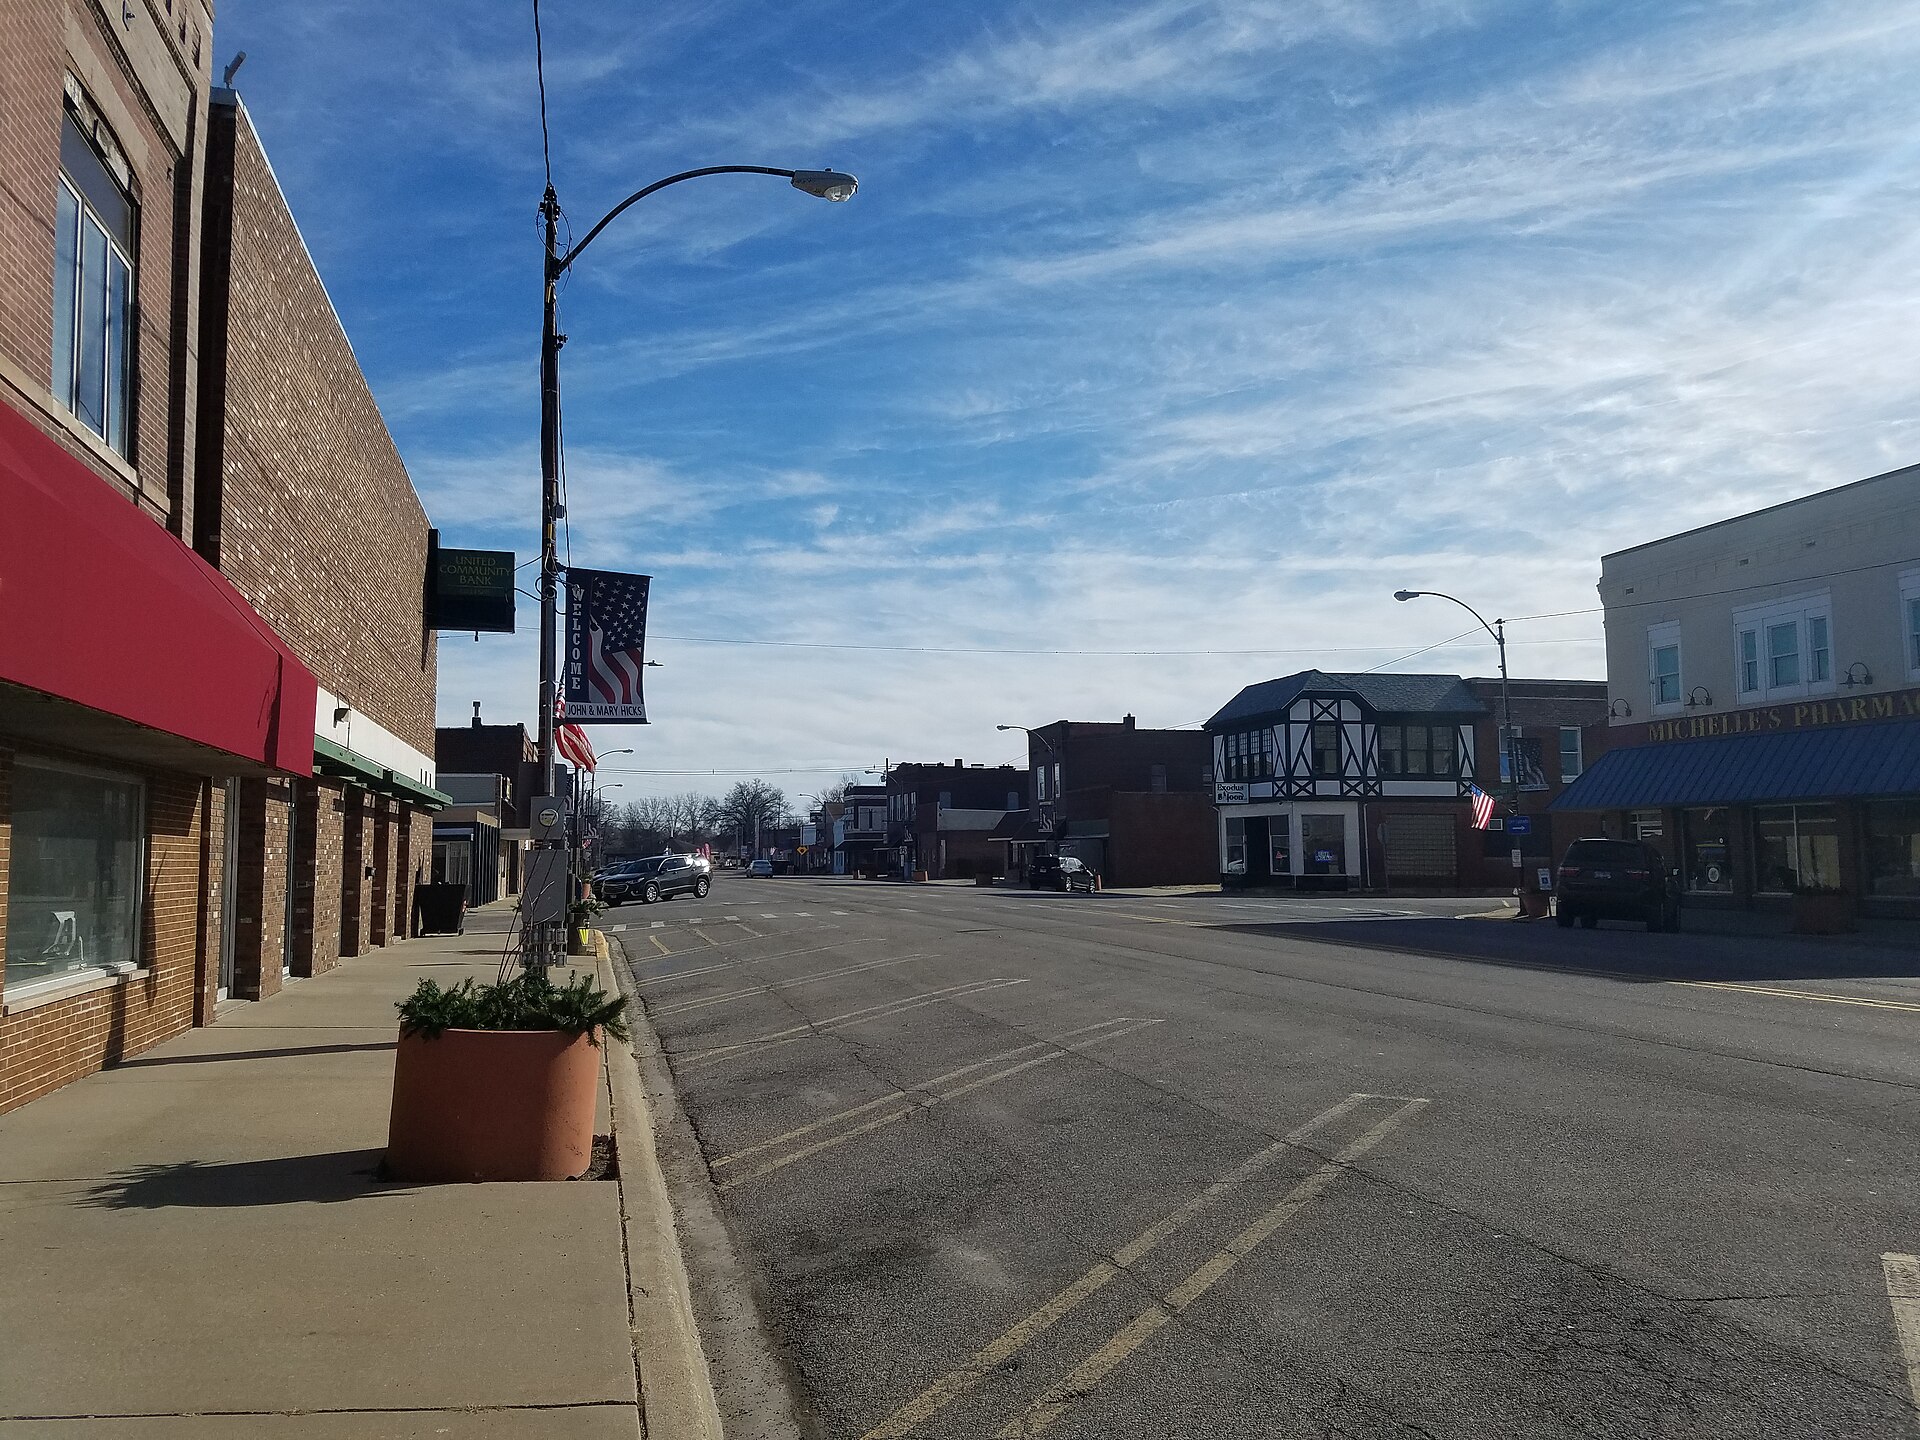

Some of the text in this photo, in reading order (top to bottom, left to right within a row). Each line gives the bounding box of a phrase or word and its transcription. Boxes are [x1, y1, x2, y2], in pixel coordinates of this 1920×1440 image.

[455, 556, 496, 567] UNITED
[439, 564, 512, 577] COMMUNITY
[459, 575, 491, 585] BANK
[570, 586, 585, 690] WELCOME
[568, 704, 642, 716] JOHN & MARY HICKS
[1648, 708, 1783, 743] MICHELLE'S
